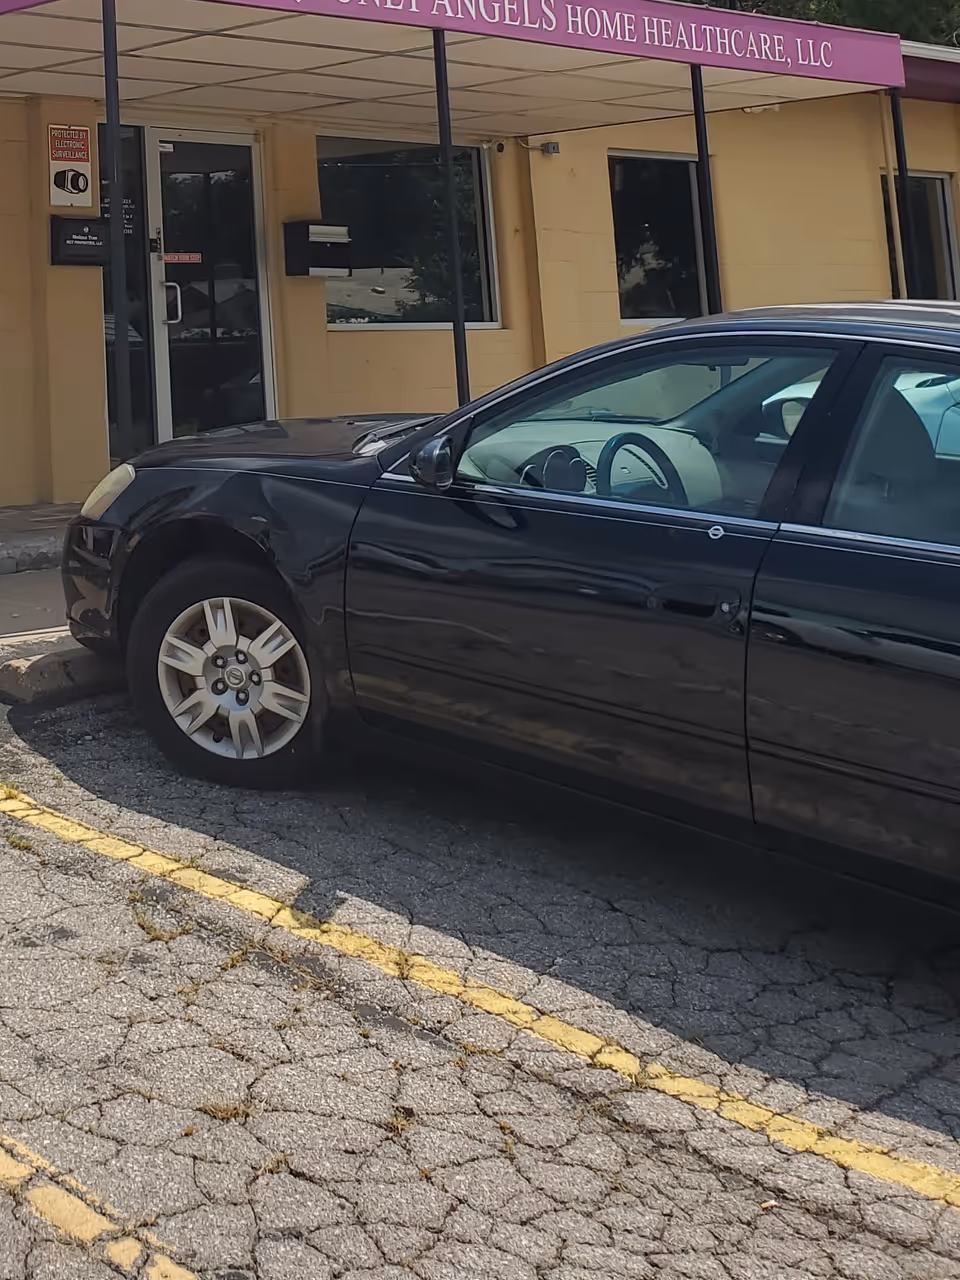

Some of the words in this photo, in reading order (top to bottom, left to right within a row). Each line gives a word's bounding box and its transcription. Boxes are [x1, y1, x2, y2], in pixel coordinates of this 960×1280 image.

[565, 3, 637, 43] HOME
[642, 15, 792, 69] HEALTHCARE,
[796, 37, 834, 68] LLC
[51, 129, 79, 138] PROTECTED
[55, 140, 85, 149] ELECTRONIC
[52, 150, 88, 159] SURVEILLANCE
